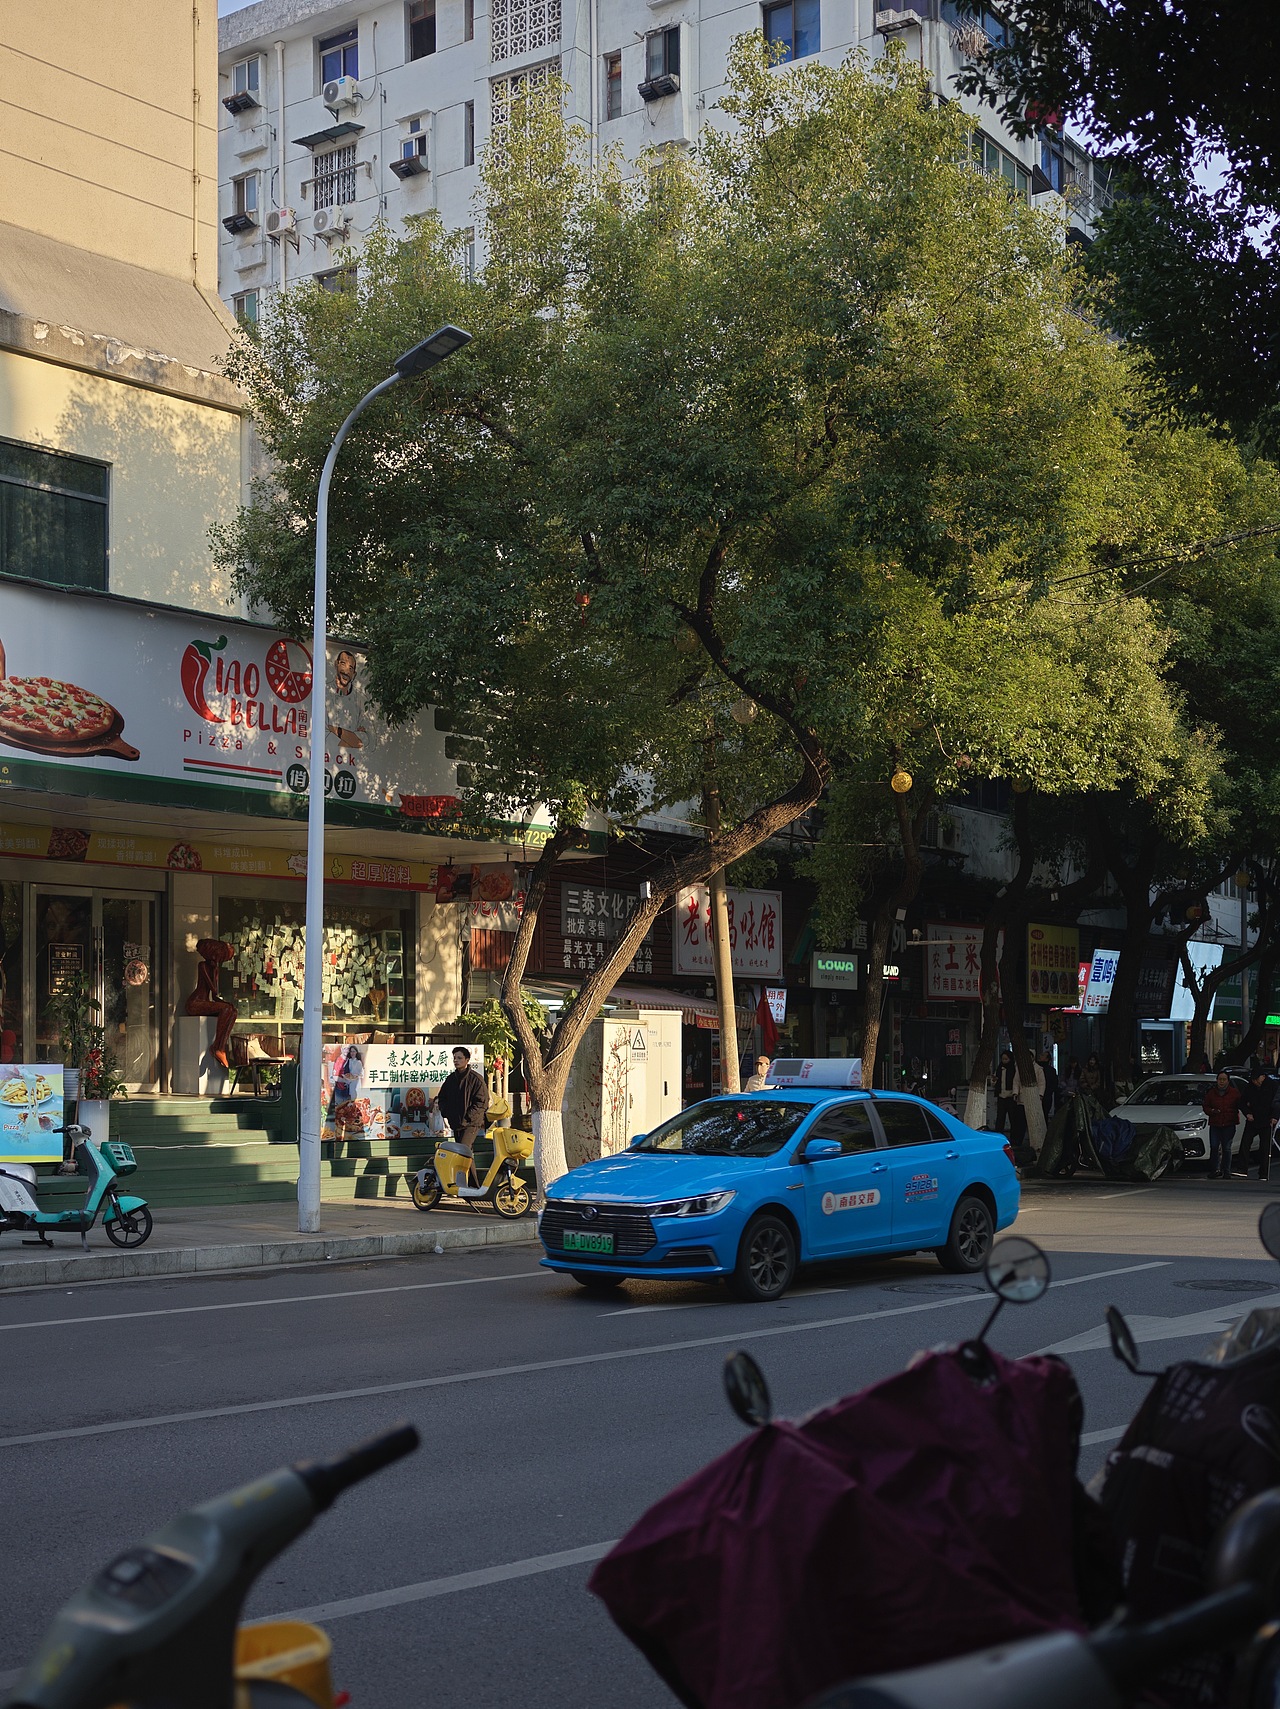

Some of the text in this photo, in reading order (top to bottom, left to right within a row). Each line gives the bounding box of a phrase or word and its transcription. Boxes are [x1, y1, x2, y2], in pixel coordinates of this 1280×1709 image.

[230, 697, 297, 736] BELLA
[298, 708, 308, 738] 南昌
[183, 729, 356, 766] Pizza & Sack
[351, 861, 411, 884] 超厚馅料
[567, 918, 586, 935] 批发
[588, 919, 606, 937] 零售
[818, 959, 854, 972] LOWA
[387, 1050, 449, 1068] 意大利大厨
[4, 1124, 19, 1132] Pizza
[905, 1180, 932, 1192] 95128
